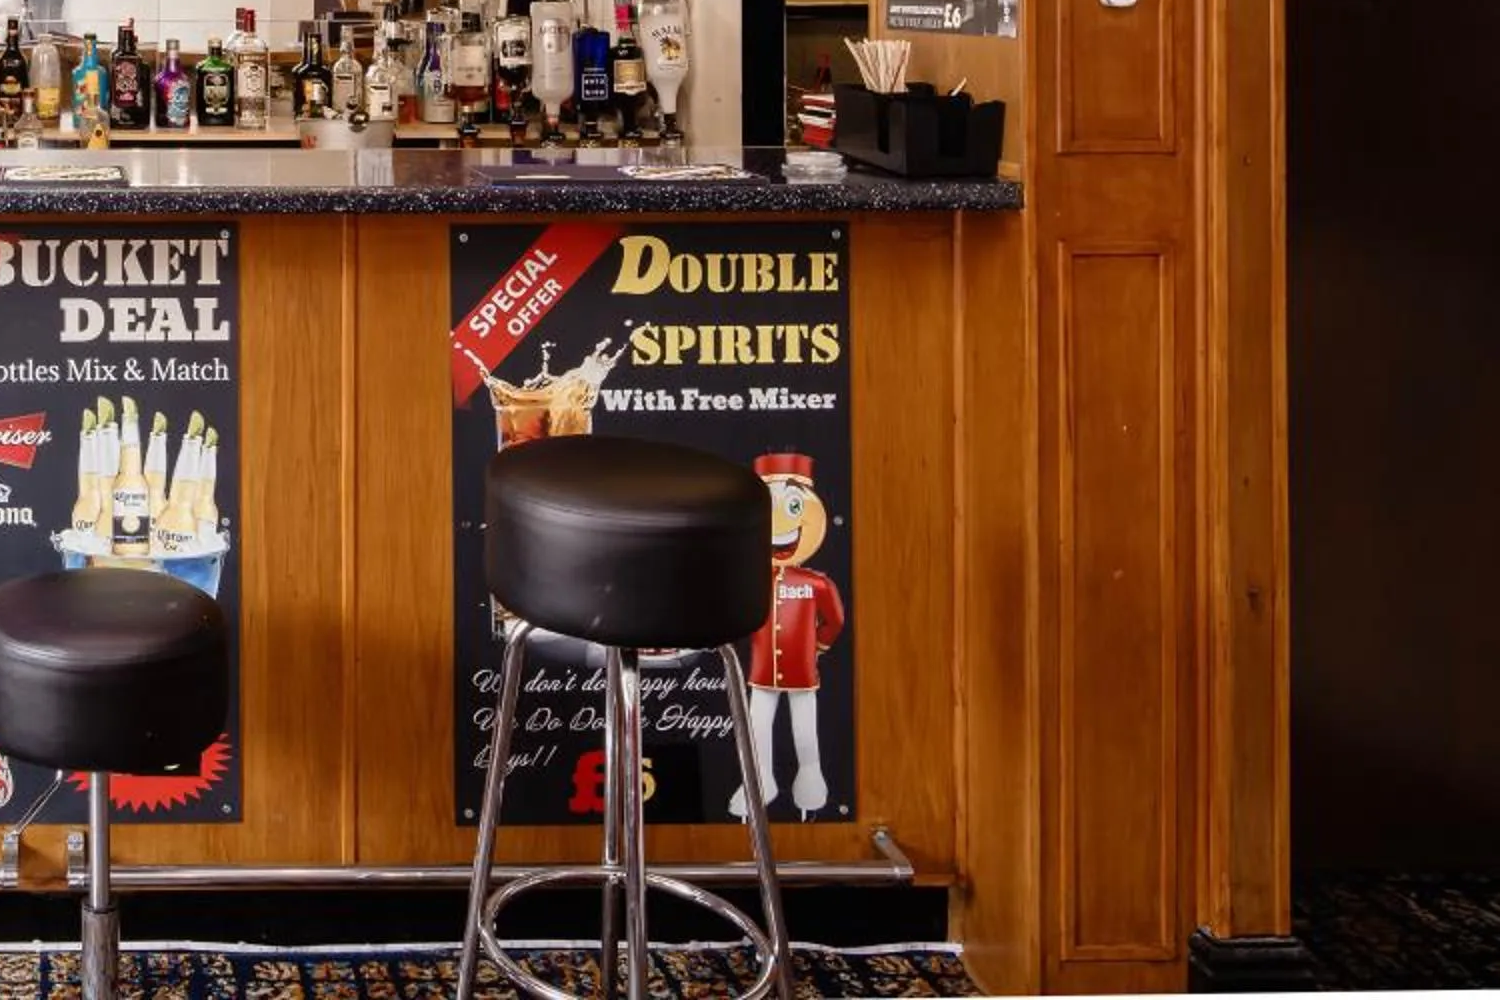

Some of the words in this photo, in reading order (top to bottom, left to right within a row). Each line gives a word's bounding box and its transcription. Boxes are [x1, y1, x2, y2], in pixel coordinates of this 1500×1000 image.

[612, 235, 840, 295] DOUBLE
[469, 245, 559, 339] SPECIAL
[507, 277, 564, 338] OFFER
[60, 298, 230, 342] DEAL
[631, 322, 841, 366] SPIRITS
[68, 359, 118, 381] Mix
[123, 359, 145, 381] &
[151, 358, 230, 381] Match
[601, 389, 676, 412] With
[681, 389, 744, 411] Free
[748, 388, 837, 410] Mixer
[779, 584, 813, 599] Bach
[525, 669, 578, 693] don't
[525, 707, 563, 732] Do
[656, 704, 736, 738] Happy
[473, 745, 557, 778] Dys!!
